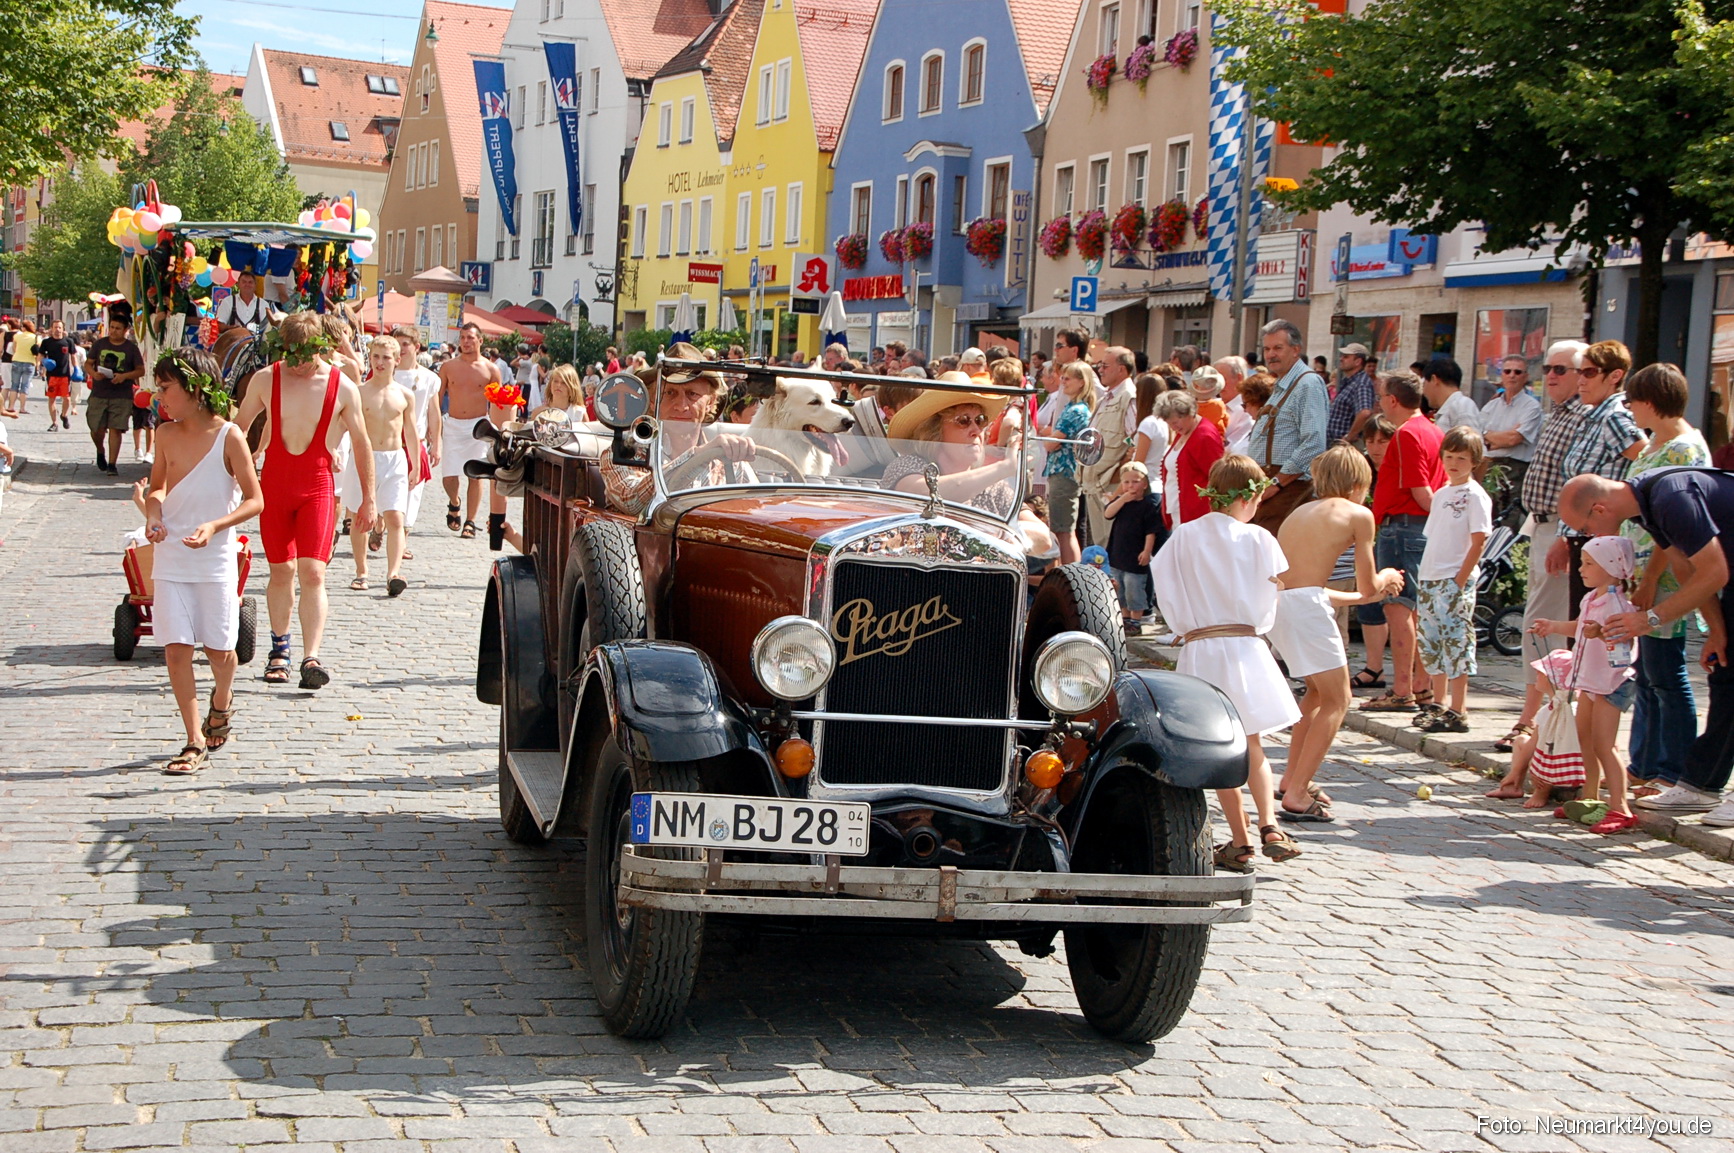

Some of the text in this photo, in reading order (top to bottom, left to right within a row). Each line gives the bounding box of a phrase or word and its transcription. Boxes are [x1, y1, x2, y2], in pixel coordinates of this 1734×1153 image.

[668, 169, 725, 194] HOTEL Lehmeier
[1013, 209, 1027, 280] WITTL
[1297, 233, 1309, 297] KINO
[1338, 242, 1347, 275] P
[751, 262, 757, 286] P
[842, 274, 905, 301] APOTHEKE
[378, 282, 384, 300] P
[660, 280, 693, 296] Restaurant
[1075, 280, 1093, 308] P
[830, 595, 963, 666] Praga
[636, 800, 839, 846] D NM BJ 28
[848, 810, 864, 822] 04
[848, 836, 863, 848] 10
